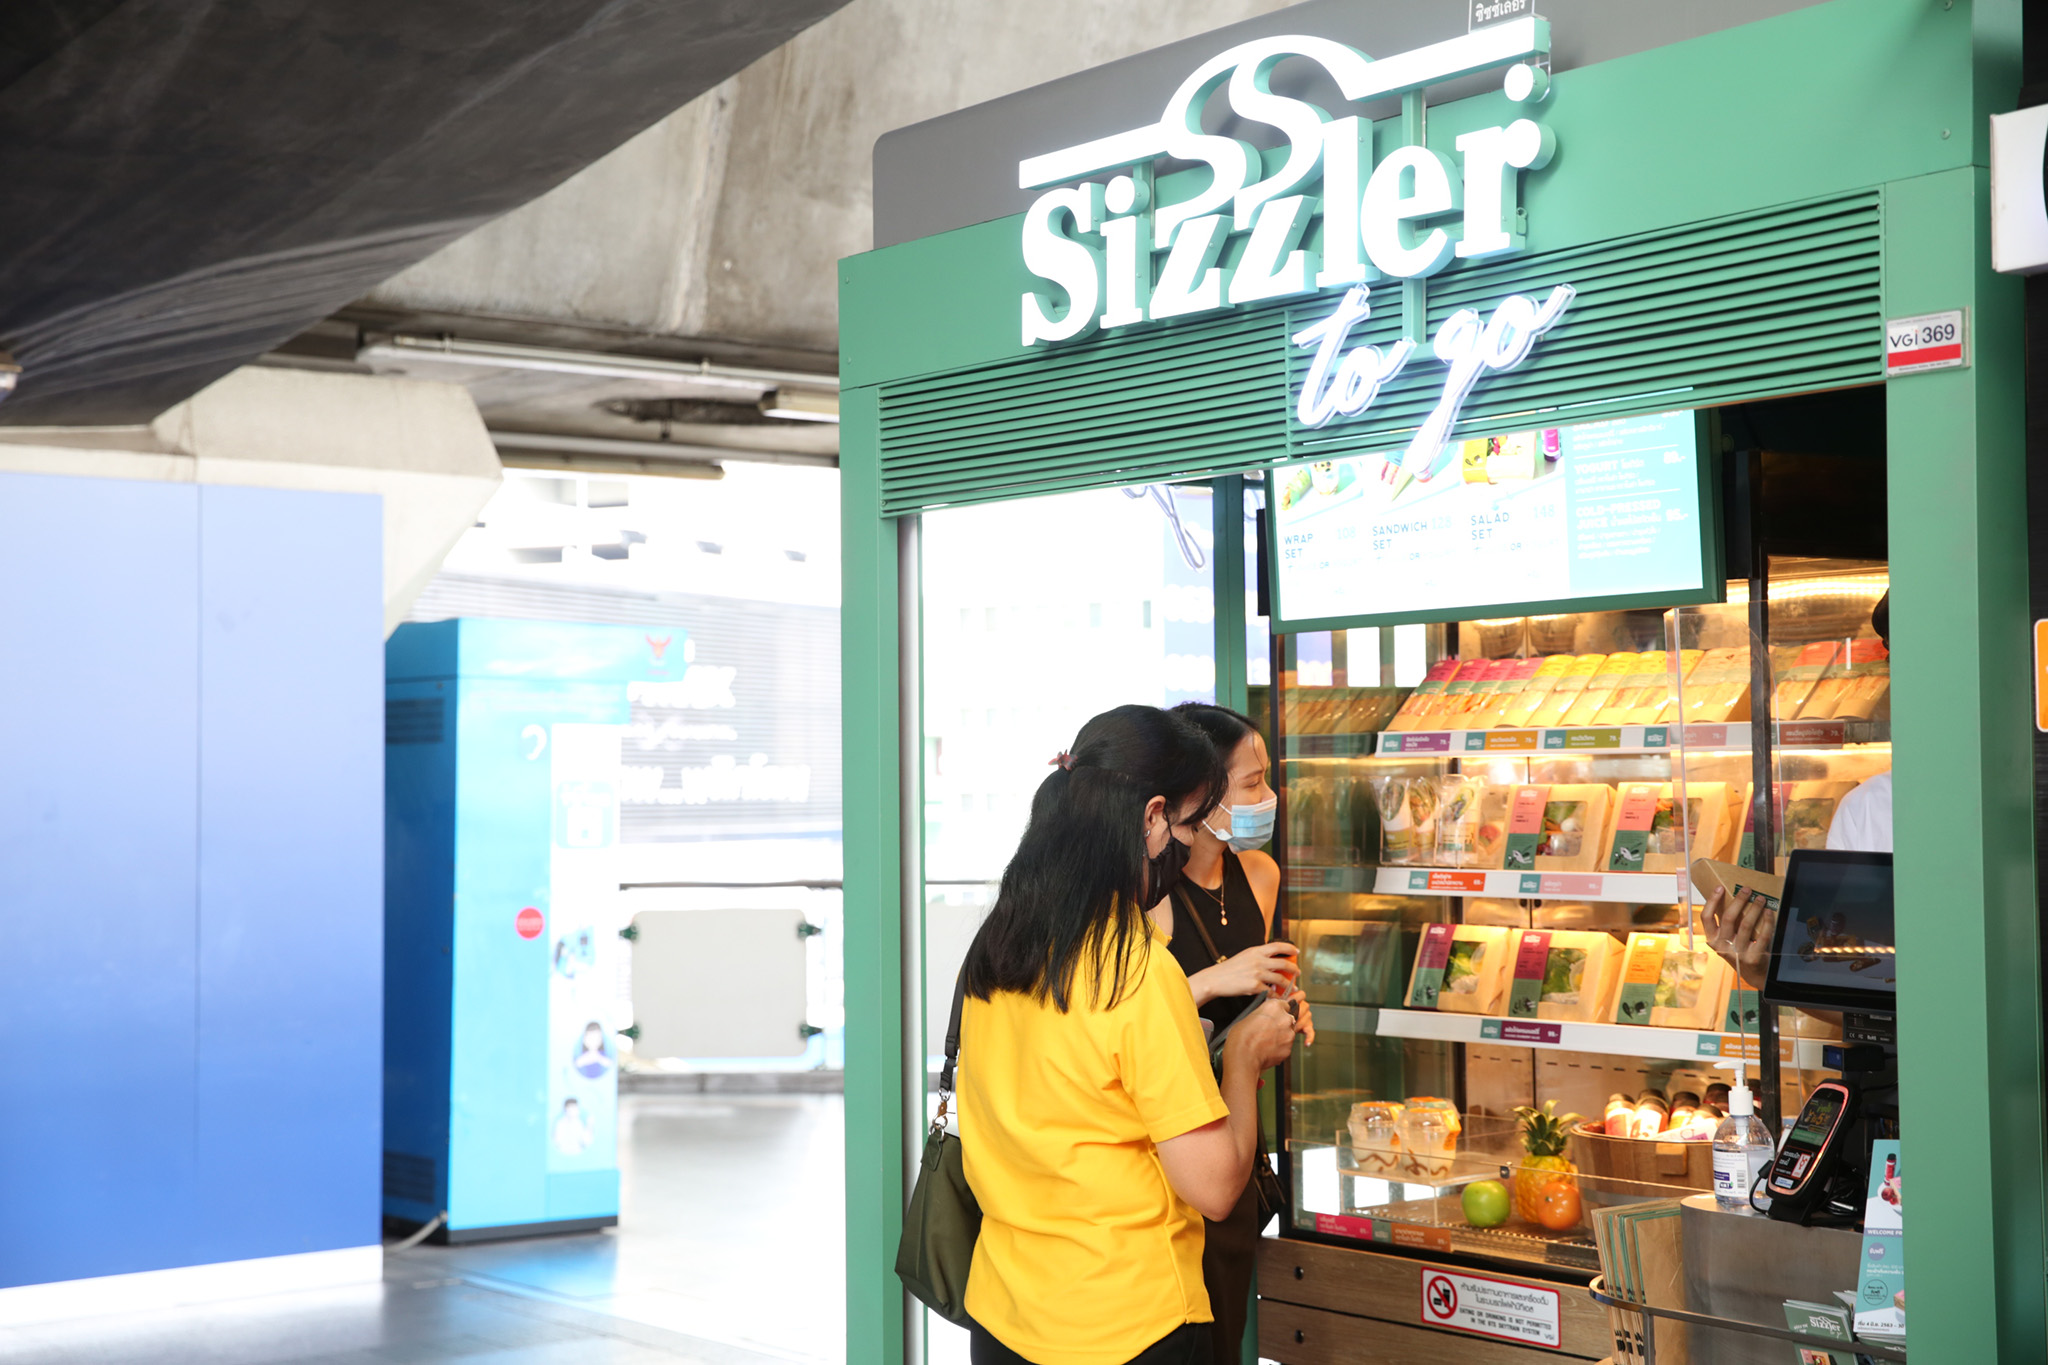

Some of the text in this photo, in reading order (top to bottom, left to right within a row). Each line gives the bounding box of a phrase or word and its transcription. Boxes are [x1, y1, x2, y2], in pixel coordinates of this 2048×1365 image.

[1019, 17, 1555, 347] Sizzler
[1922, 323, 1955, 344] 369
[1292, 283, 1577, 480] to go
[1574, 460, 1618, 474] YOGURT
[1533, 504, 1555, 519] 148
[1575, 499, 1661, 517] COLD-PRESSED
[1431, 515, 1452, 529] 128
[1470, 512, 1510, 526] SALAD
[1576, 517, 1608, 529] JUICE
[1372, 521, 1428, 536] SANDWICH
[1471, 528, 1493, 540] SET
[1284, 533, 1314, 545] WRAP
[1373, 538, 1392, 550] SET
[1284, 548, 1303, 559] SET
[1460, 1307, 1475, 1316] EATING
[1485, 1312, 1506, 1322] DRINKING
[1526, 1320, 1552, 1330] PERMITTED
[1809, 1316, 1841, 1332] Sizzler
[1477, 1318, 1486, 1326] THE
[1498, 1322, 1520, 1332] SKYTRAIN
[1522, 1327, 1540, 1336] SYSTEM
